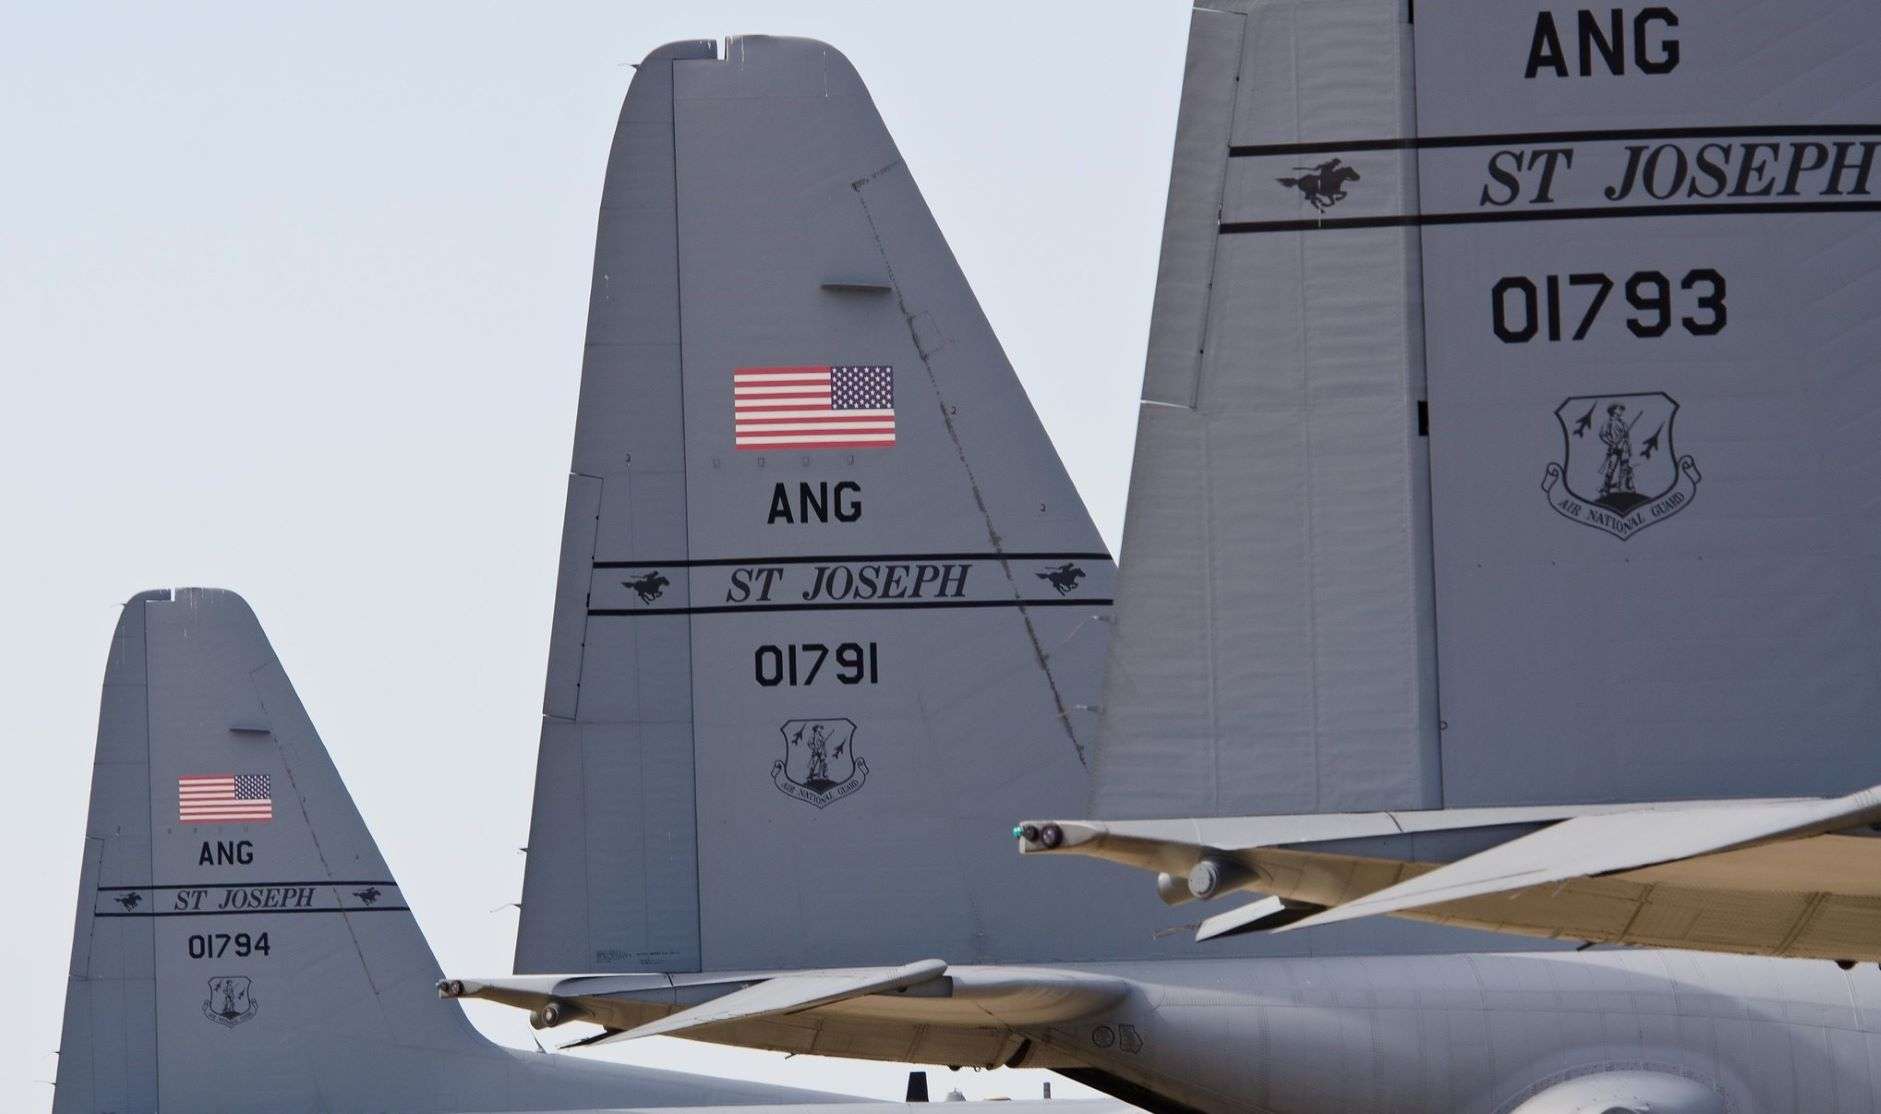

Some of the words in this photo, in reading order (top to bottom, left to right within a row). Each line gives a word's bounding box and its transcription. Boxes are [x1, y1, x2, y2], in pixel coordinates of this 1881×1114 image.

[1525, 7, 1680, 79] ANG
[1479, 148, 1574, 206] ST
[1603, 141, 1881, 201] JOSEPH
[1491, 268, 1727, 344] 01793
[767, 481, 862, 525] ANG
[1558, 500, 1581, 517] AIR
[1586, 509, 1646, 535] NATIONAL
[1651, 491, 1685, 518] GUARD
[726, 568, 783, 603] ST
[802, 564, 972, 601] JOSEPH
[754, 642, 878, 687] 01791
[199, 841, 253, 865] ANG
[174, 890, 207, 911] ST
[219, 887, 315, 909] JOSEPH
[189, 932, 270, 959] 01794
